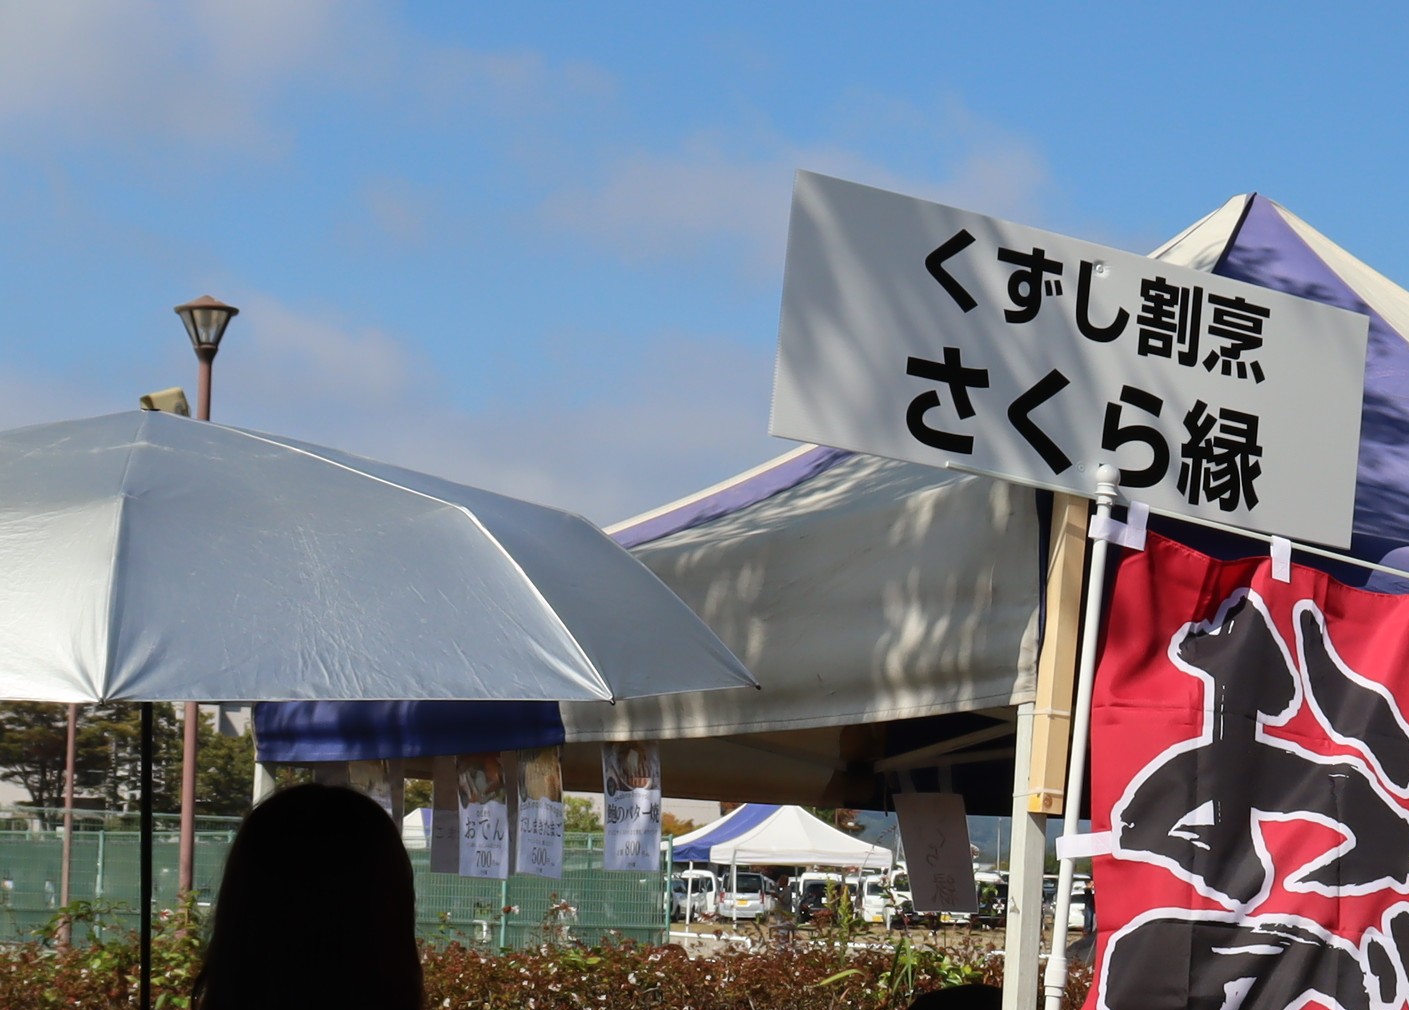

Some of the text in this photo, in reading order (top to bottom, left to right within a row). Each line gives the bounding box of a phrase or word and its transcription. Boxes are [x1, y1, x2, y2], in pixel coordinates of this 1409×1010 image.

[925, 229, 1270, 385] くずし割烹
[906, 346, 1263, 513] さくら縁
[465, 816, 505, 841] おでん
[476, 850, 492, 868] 700
